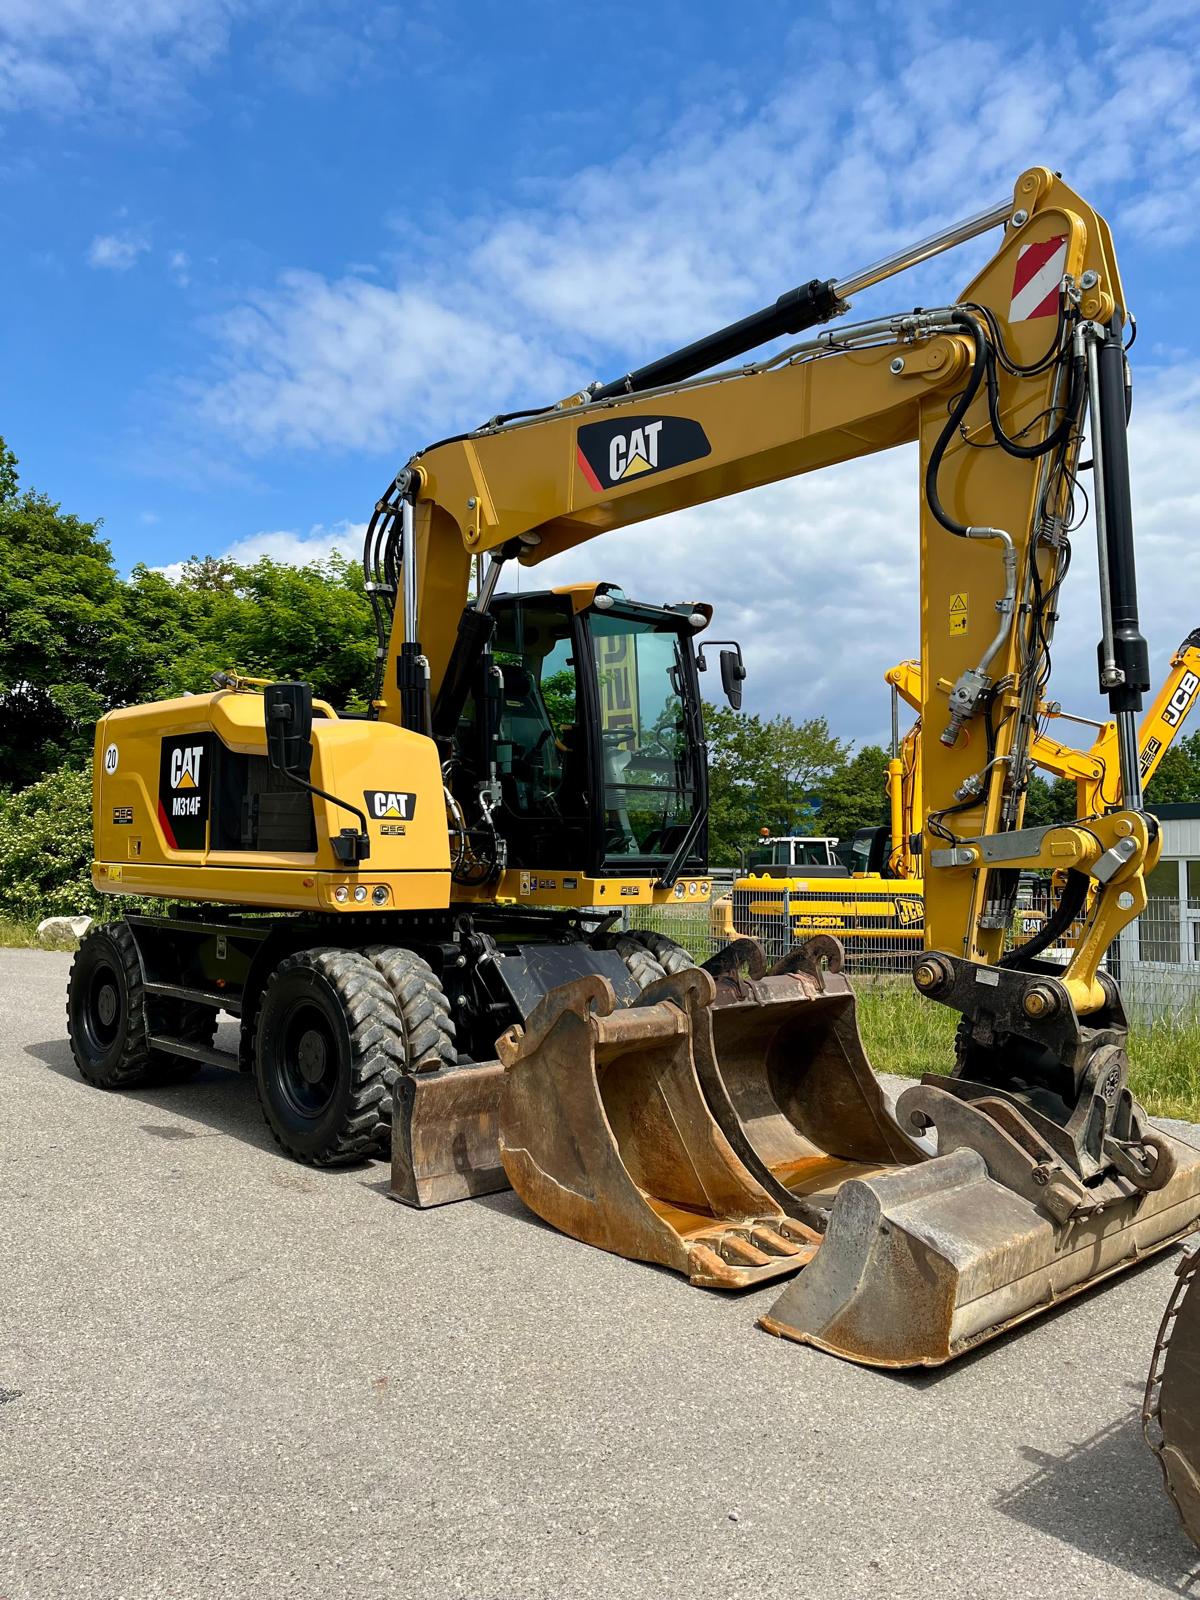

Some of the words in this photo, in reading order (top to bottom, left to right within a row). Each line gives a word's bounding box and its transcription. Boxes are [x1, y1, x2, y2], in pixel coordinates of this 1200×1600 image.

[610, 420, 663, 481] CAT
[1167, 672, 1199, 725] JCB
[107, 749, 116, 768] 20
[171, 746, 204, 789] CAT
[172, 796, 201, 816] M314F
[374, 792, 408, 818] CAT
[900, 900, 924, 923] JCB
[1023, 918, 1041, 933] CAT
